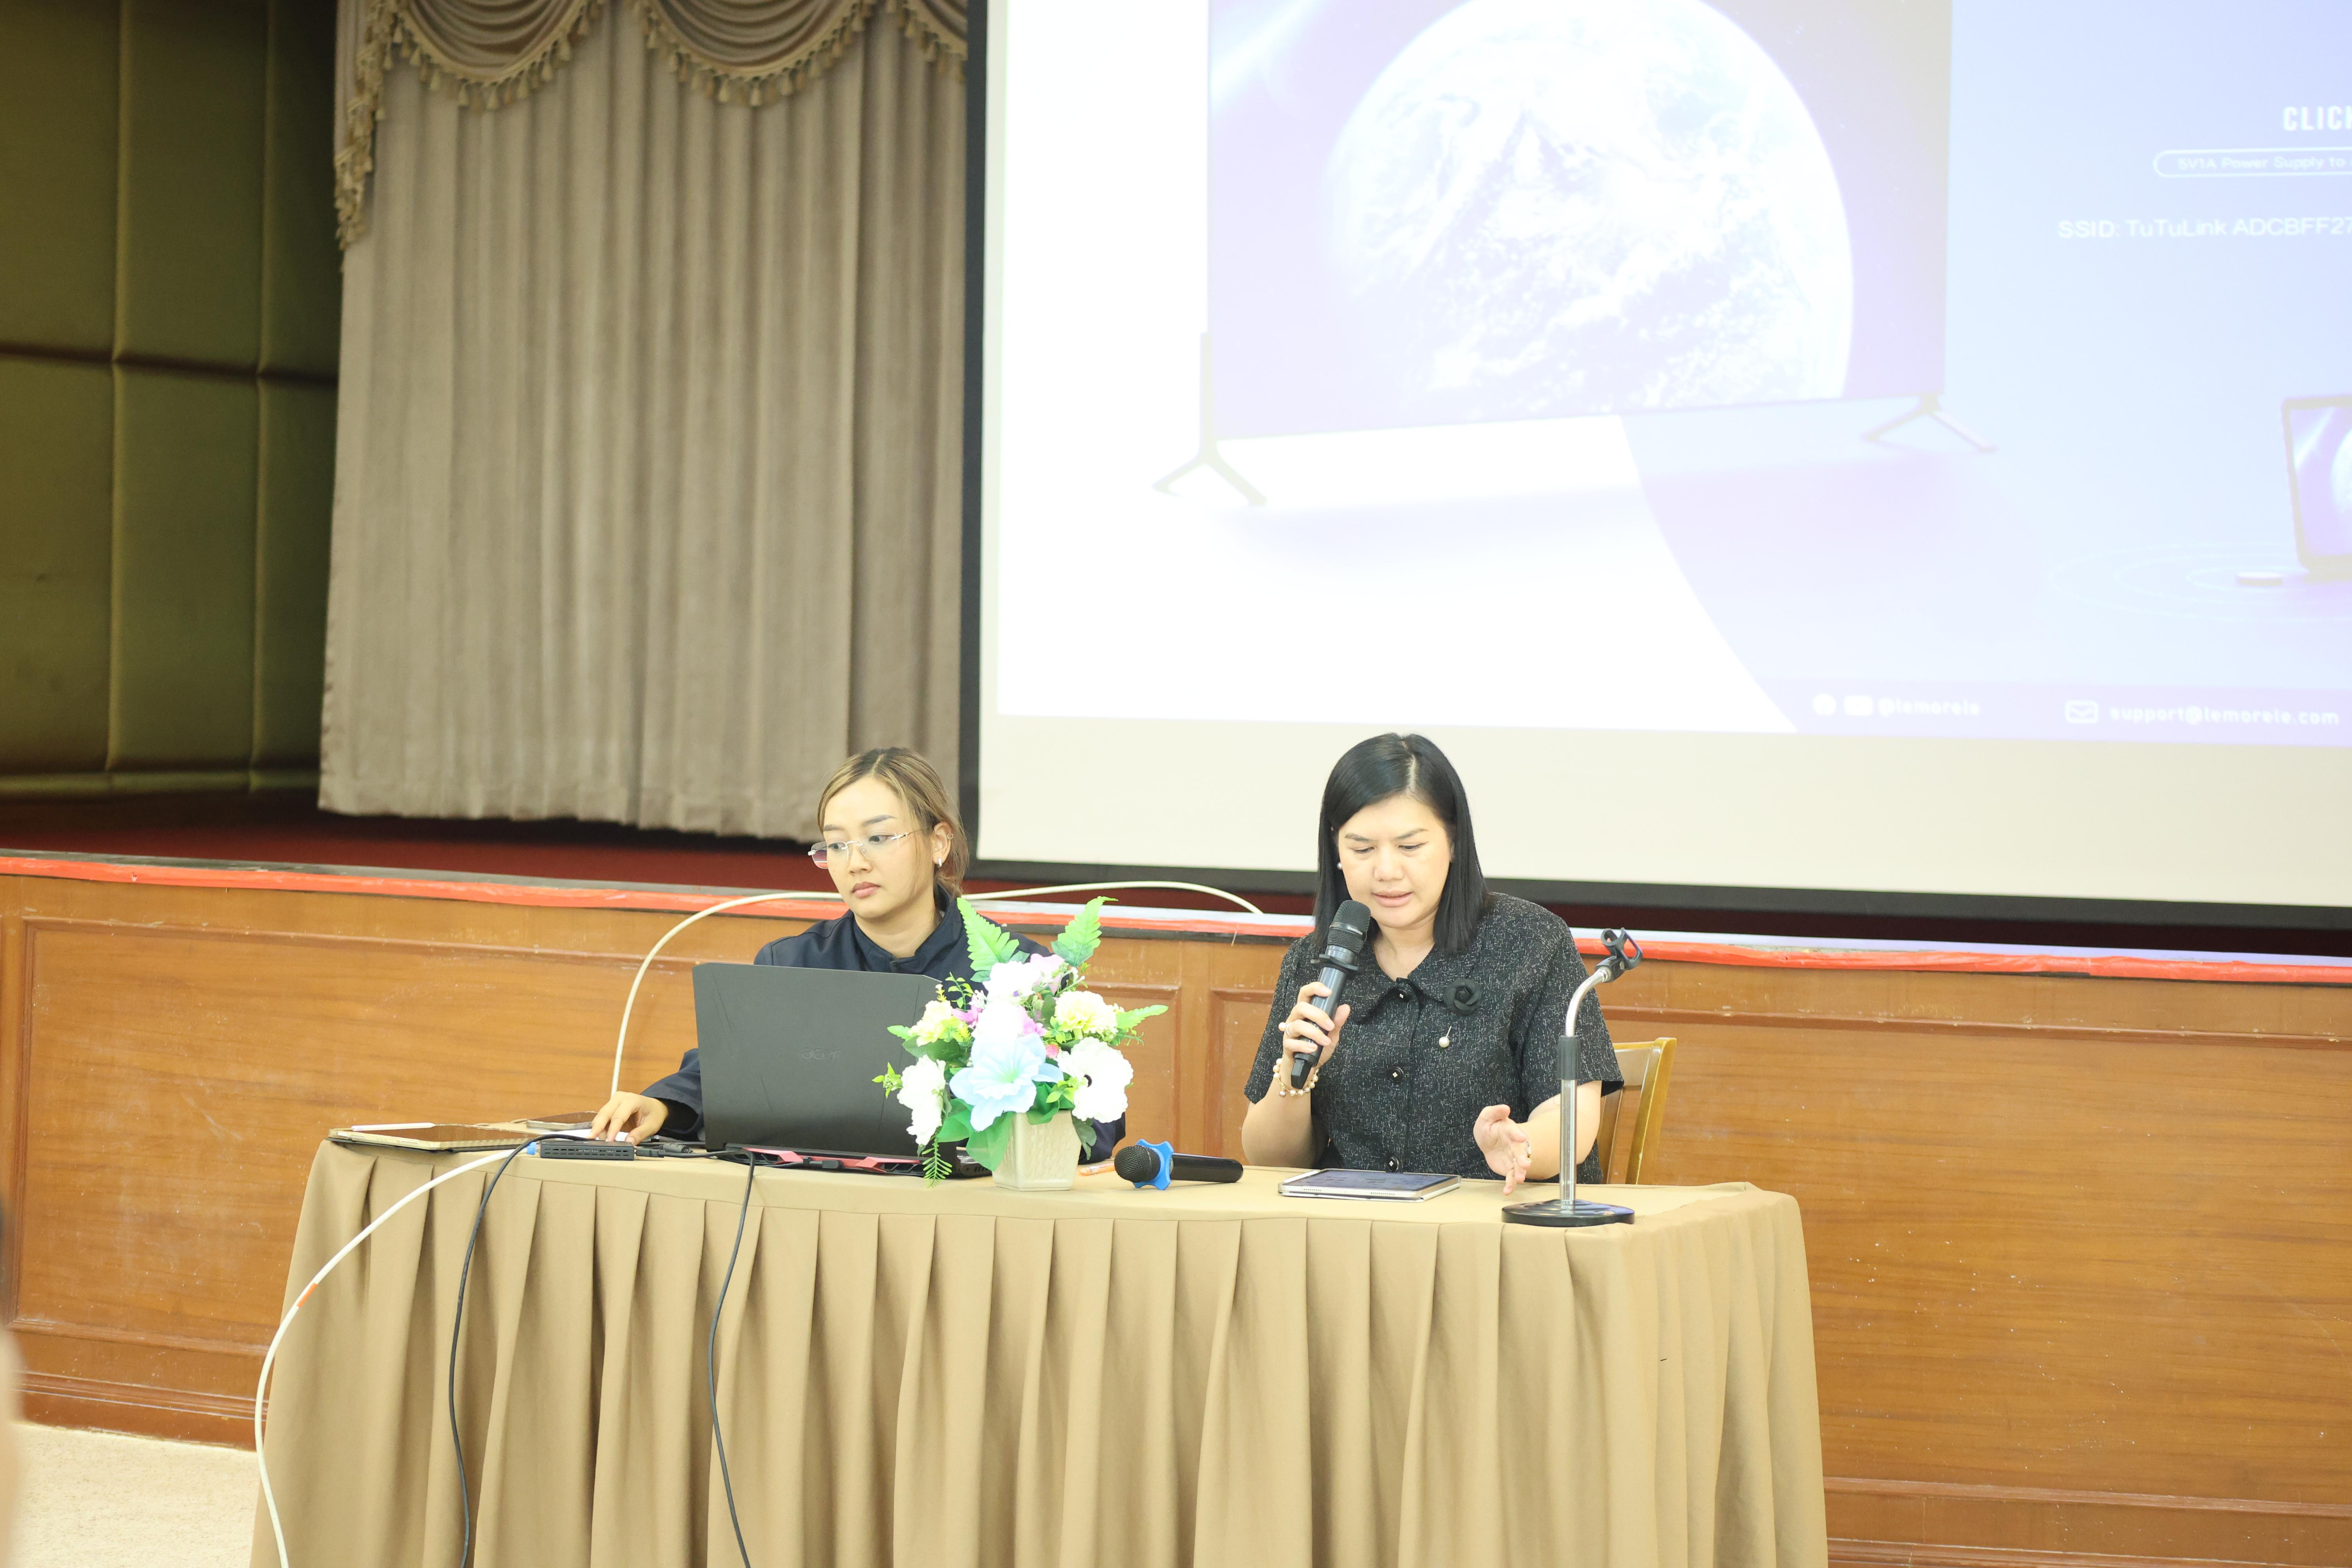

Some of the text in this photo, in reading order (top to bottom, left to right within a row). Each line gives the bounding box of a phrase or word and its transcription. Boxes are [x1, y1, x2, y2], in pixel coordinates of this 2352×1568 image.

[2222, 157, 2268, 169] Power
[2274, 156, 2324, 171] Supply
[2329, 156, 2346, 168] to
[2058, 220, 2120, 238] SSID:
[2125, 218, 2227, 237] TuTuLink
[801, 1047, 842, 1060] acer
